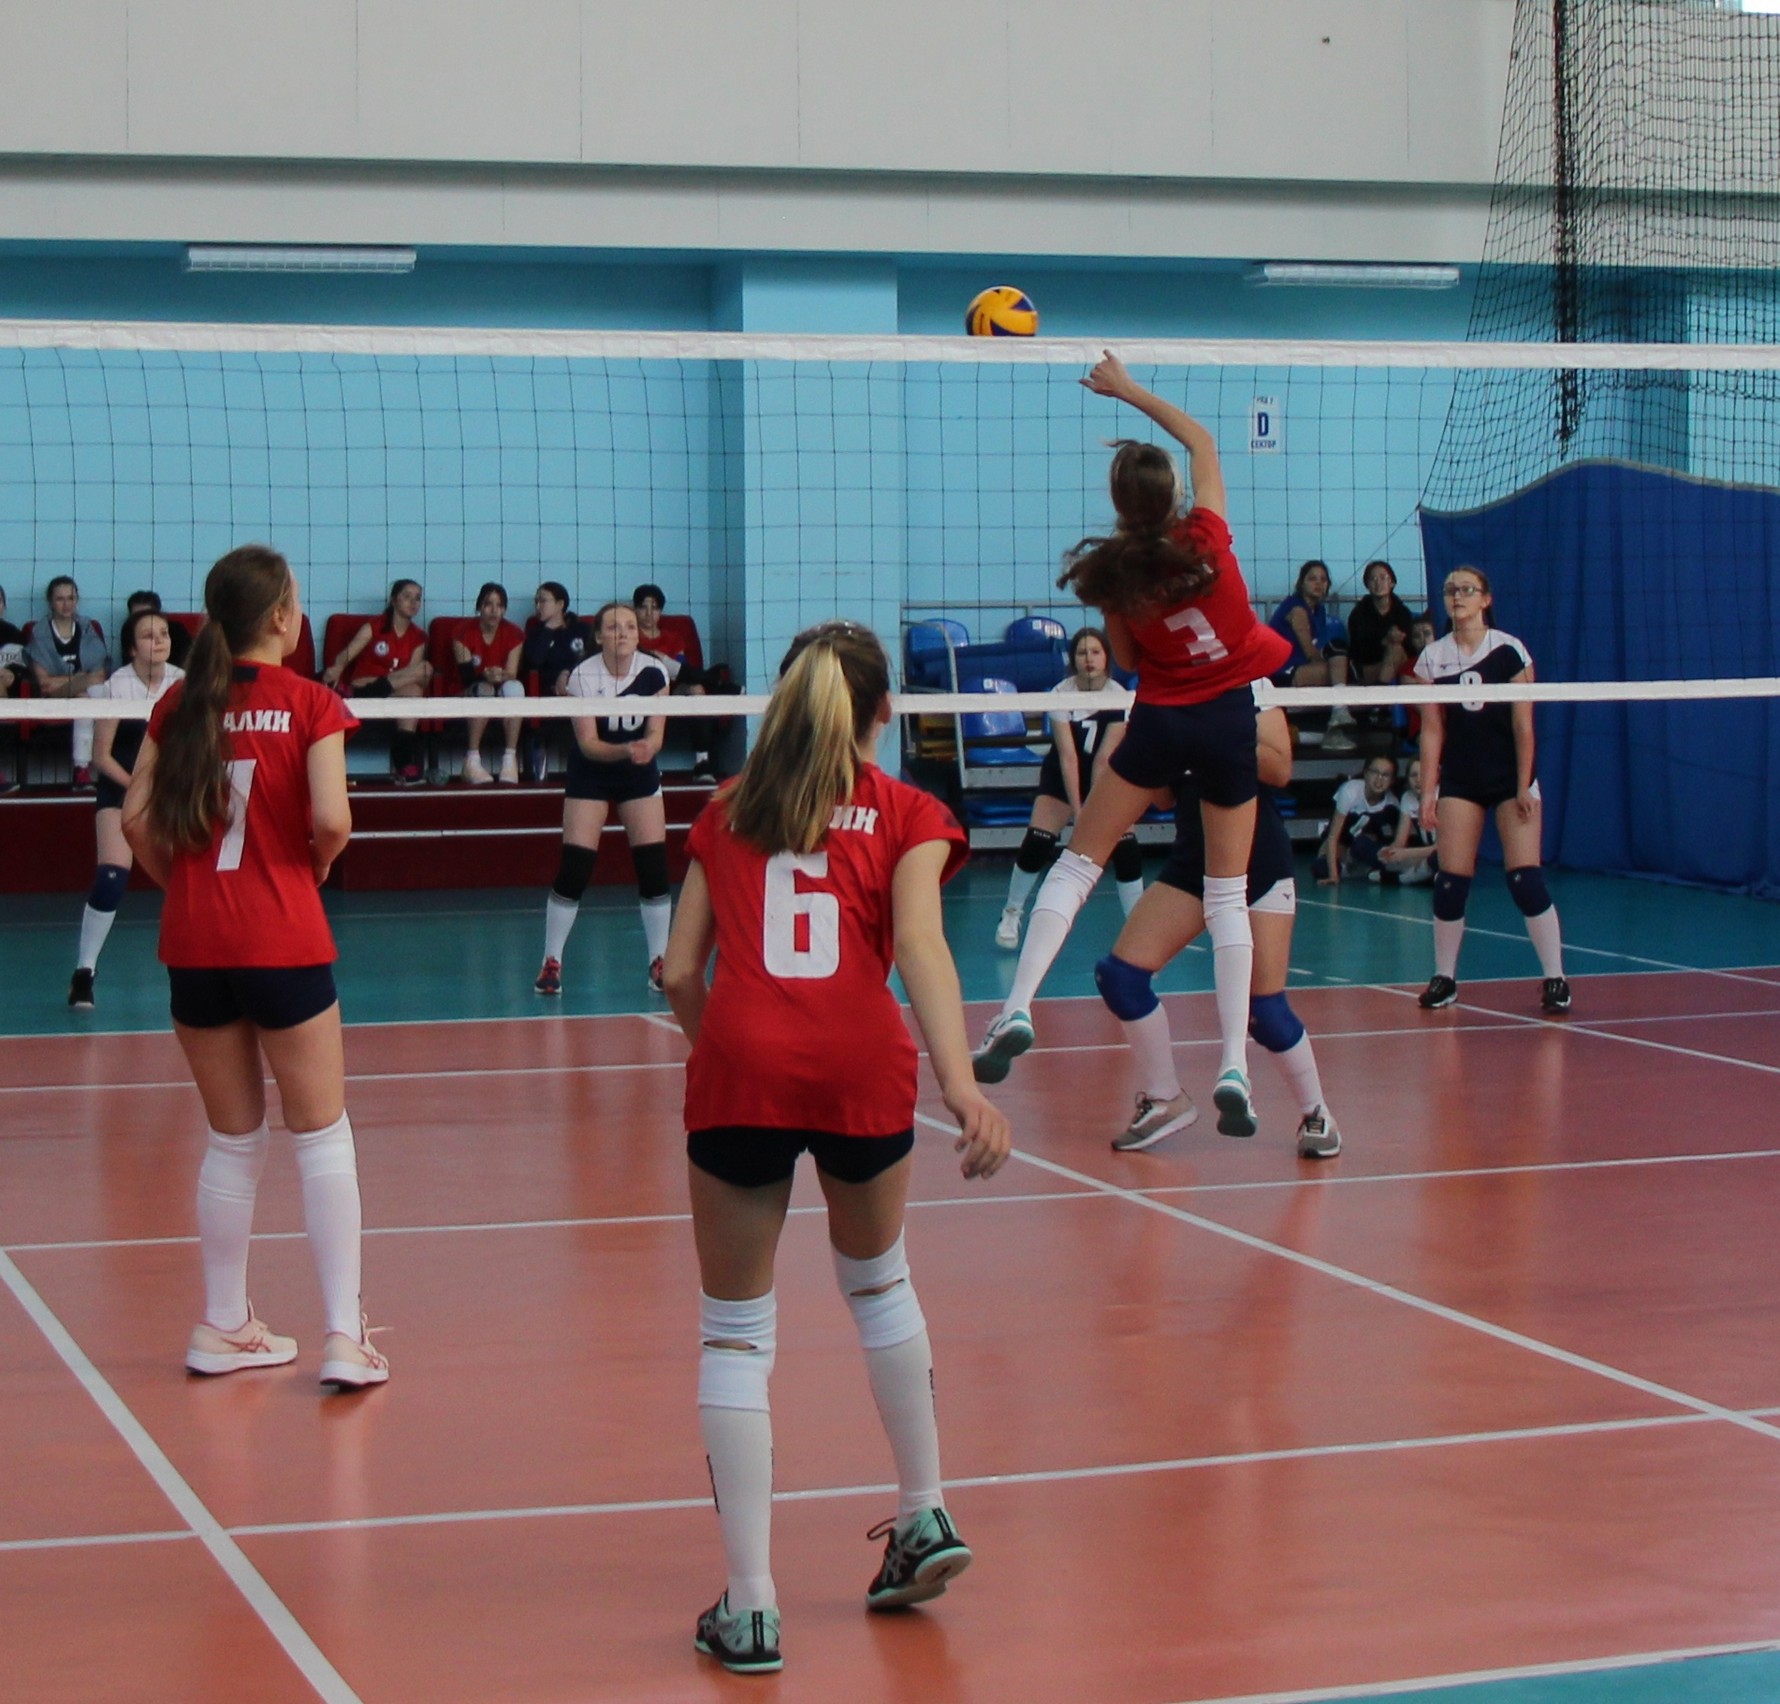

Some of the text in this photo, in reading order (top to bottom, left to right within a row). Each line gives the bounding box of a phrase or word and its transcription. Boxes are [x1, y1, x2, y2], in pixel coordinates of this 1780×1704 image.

[1257, 411, 1269, 437] D
[1163, 607, 1229, 666] 3
[222, 709, 292, 734] АЛИН
[1081, 719, 1099, 755] 7
[763, 850, 840, 979] 6
